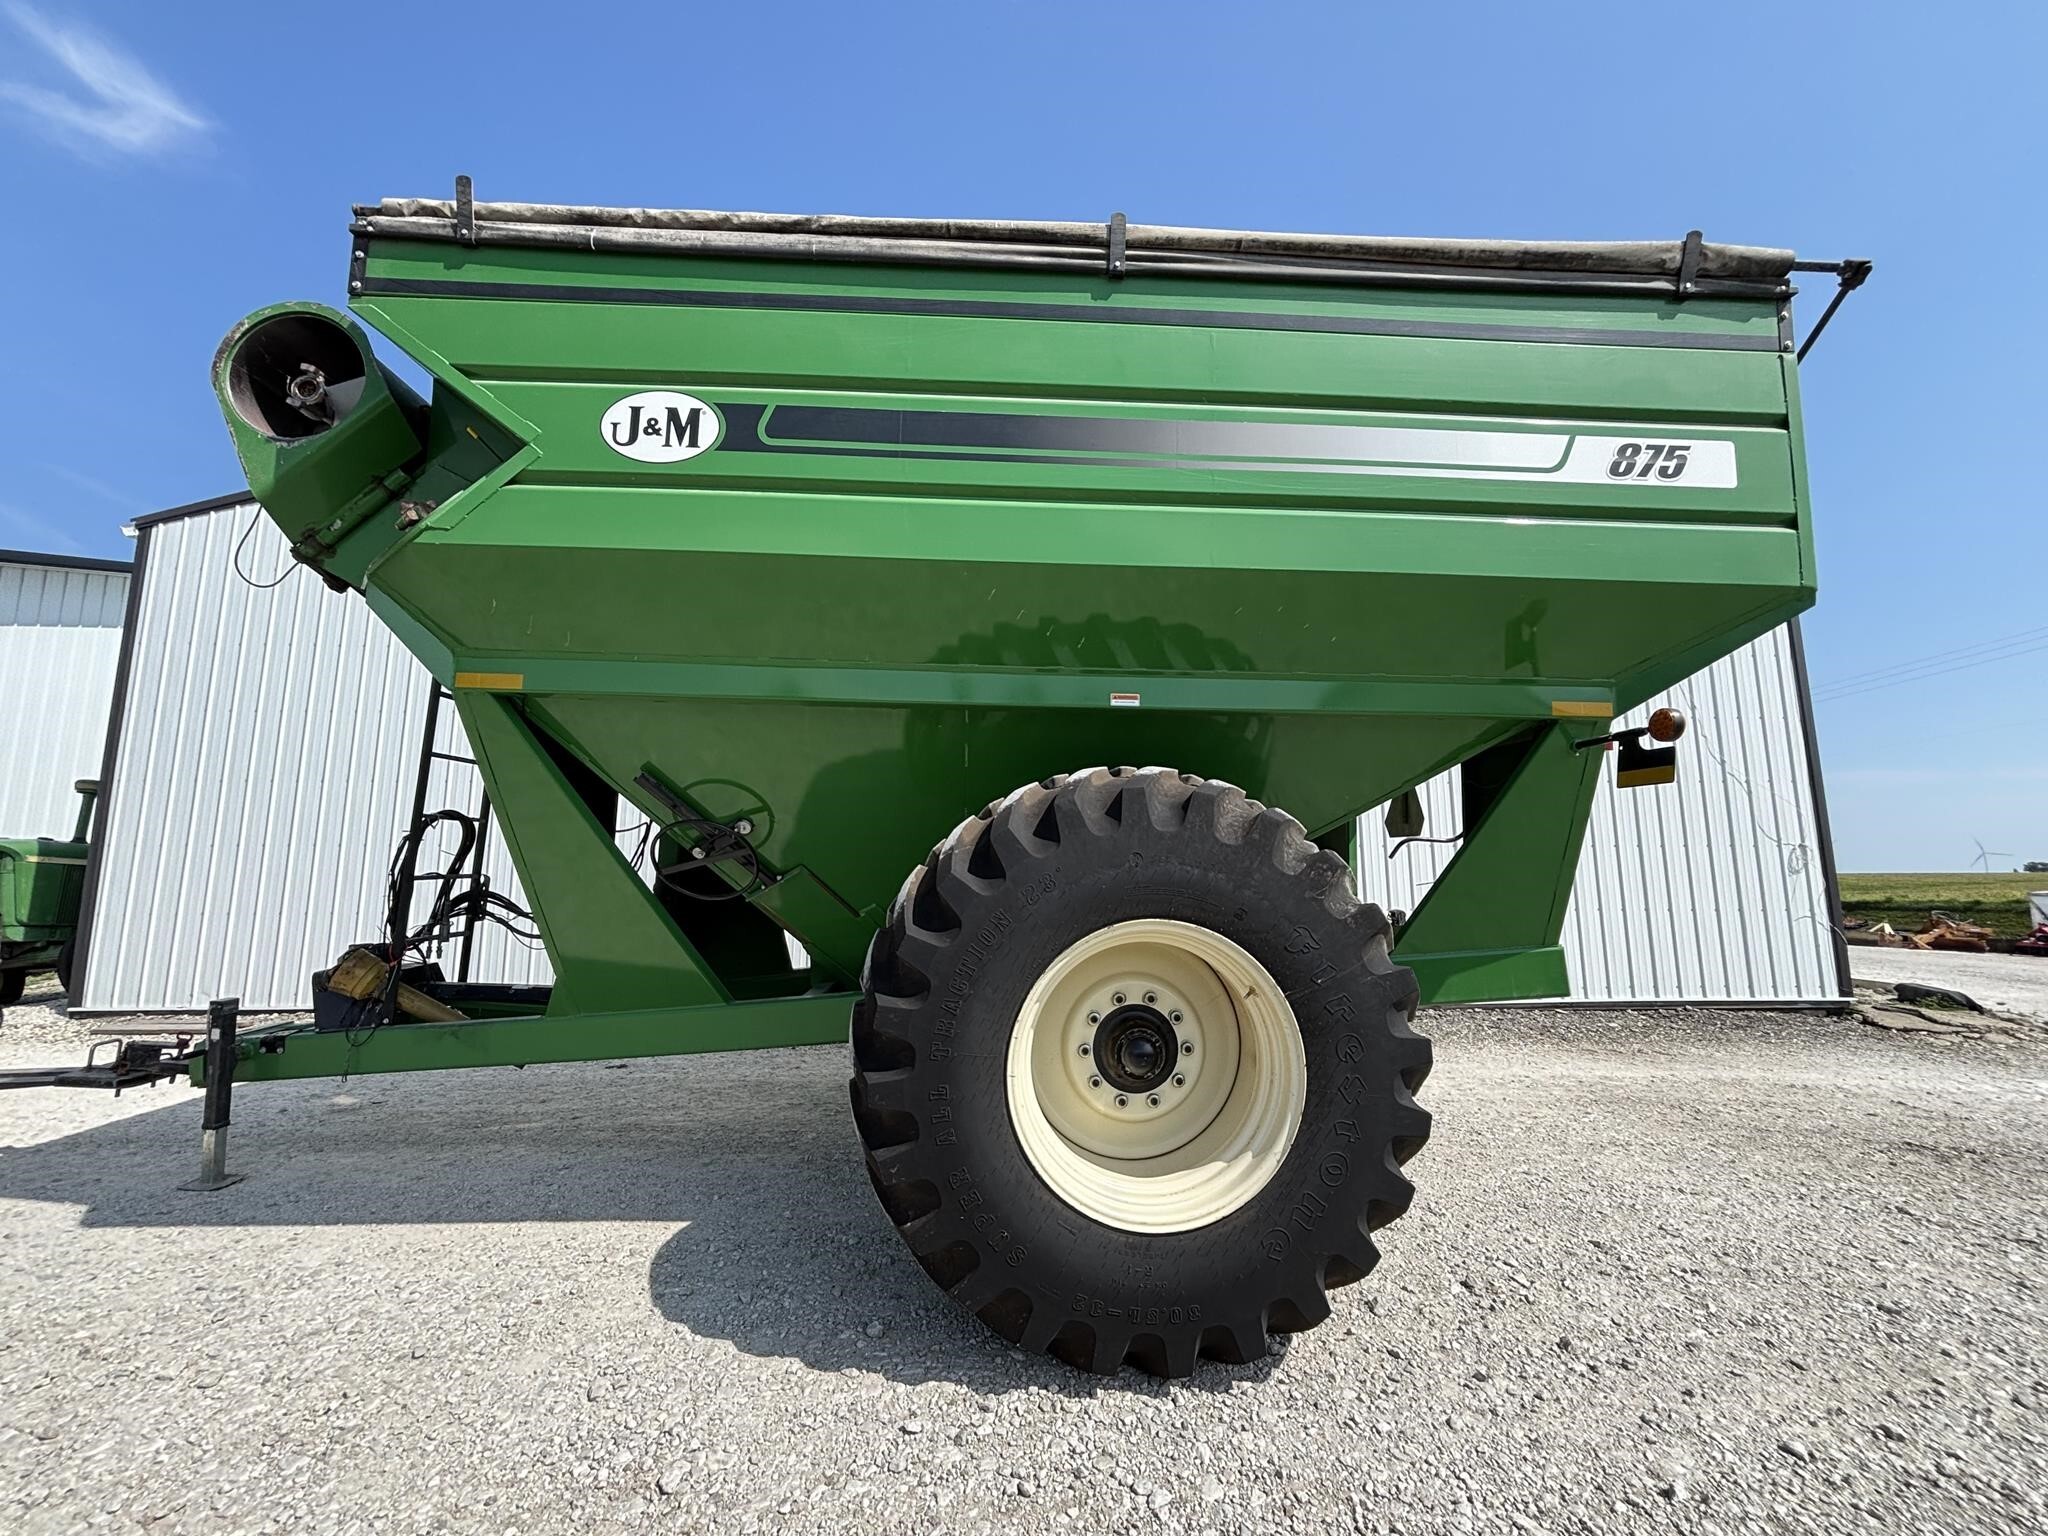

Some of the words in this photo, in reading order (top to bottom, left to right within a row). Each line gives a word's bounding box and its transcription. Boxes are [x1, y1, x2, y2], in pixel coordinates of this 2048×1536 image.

[610, 406, 704, 449] J&M
[1608, 442, 1691, 481] 875
[928, 908, 1013, 1063] TRACTION
[929, 1083, 957, 1147] ALL
